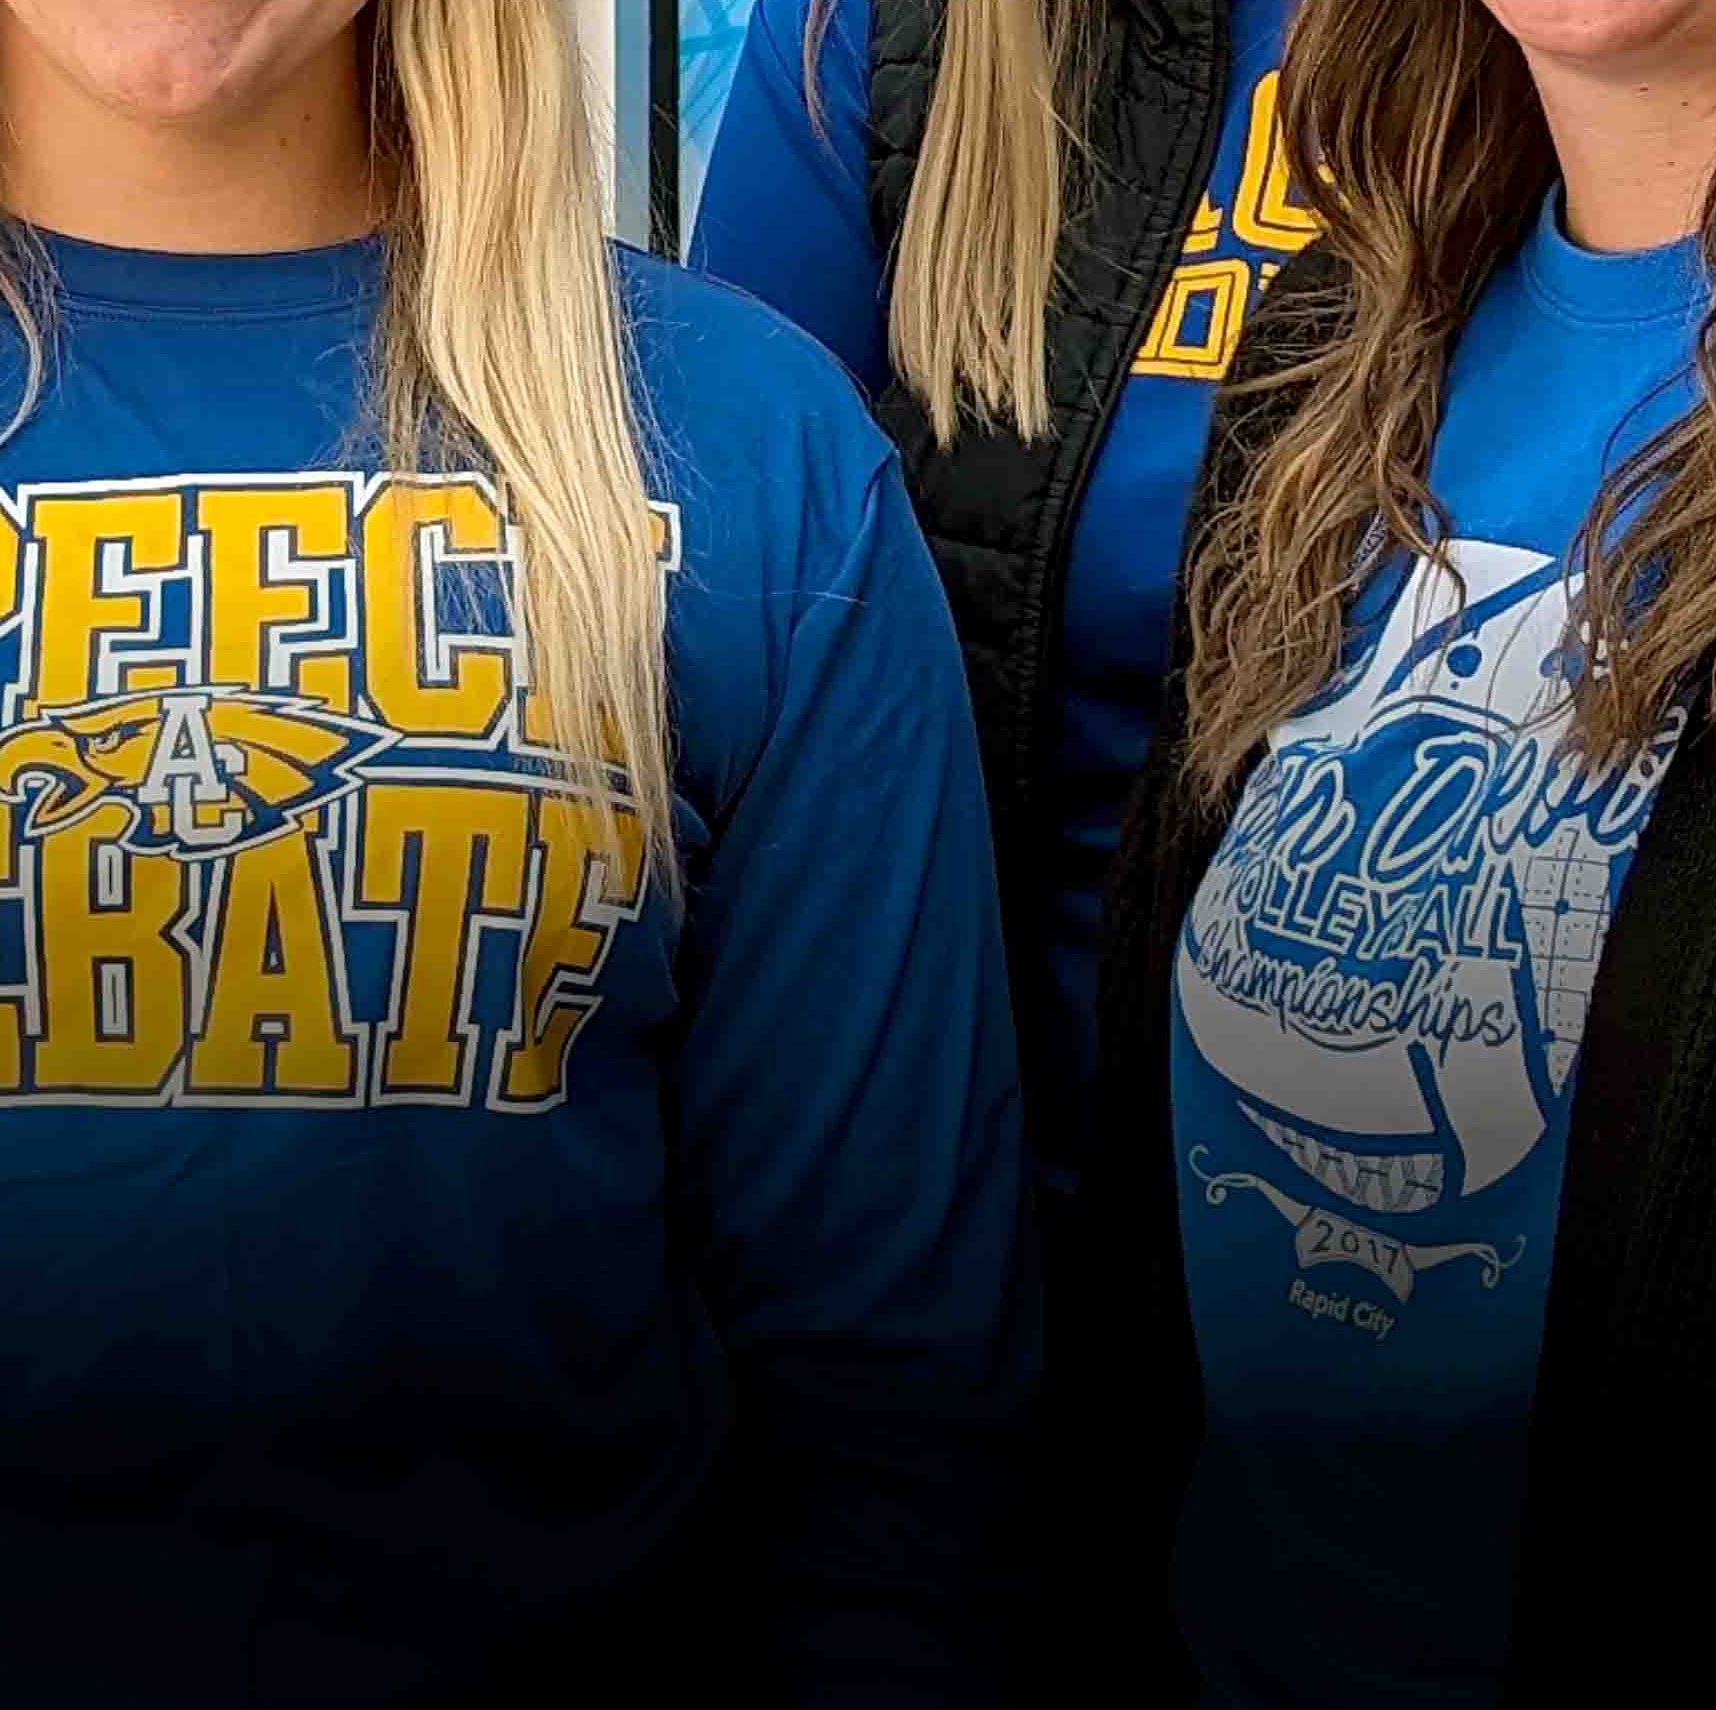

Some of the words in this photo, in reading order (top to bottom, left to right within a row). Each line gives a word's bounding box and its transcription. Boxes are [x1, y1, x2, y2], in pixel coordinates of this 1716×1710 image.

[1313, 1219, 1400, 1275] 2017
[1287, 1278, 1351, 1321] Rapid
[1351, 1299, 1395, 1342] City
